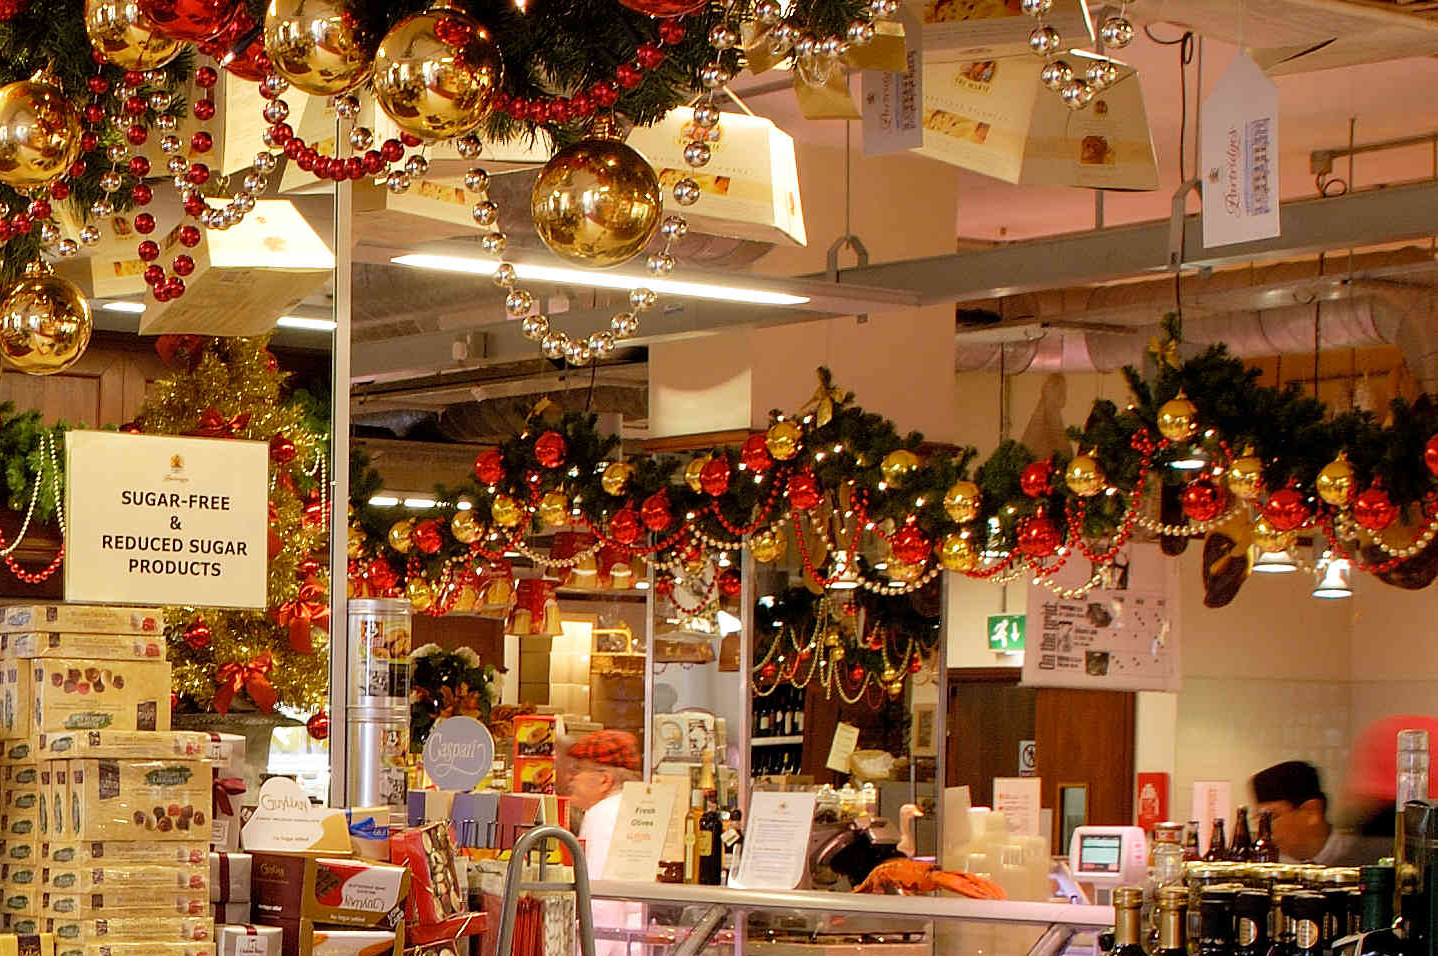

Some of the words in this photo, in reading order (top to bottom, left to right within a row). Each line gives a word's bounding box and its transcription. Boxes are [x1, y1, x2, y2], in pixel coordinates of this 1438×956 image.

[121, 491, 231, 511] SUGAR-FREE
[170, 516, 181, 530] &
[102, 535, 183, 552] REDUCED
[189, 540, 248, 555] SUGAR
[129, 559, 221, 576] PRODUCTS
